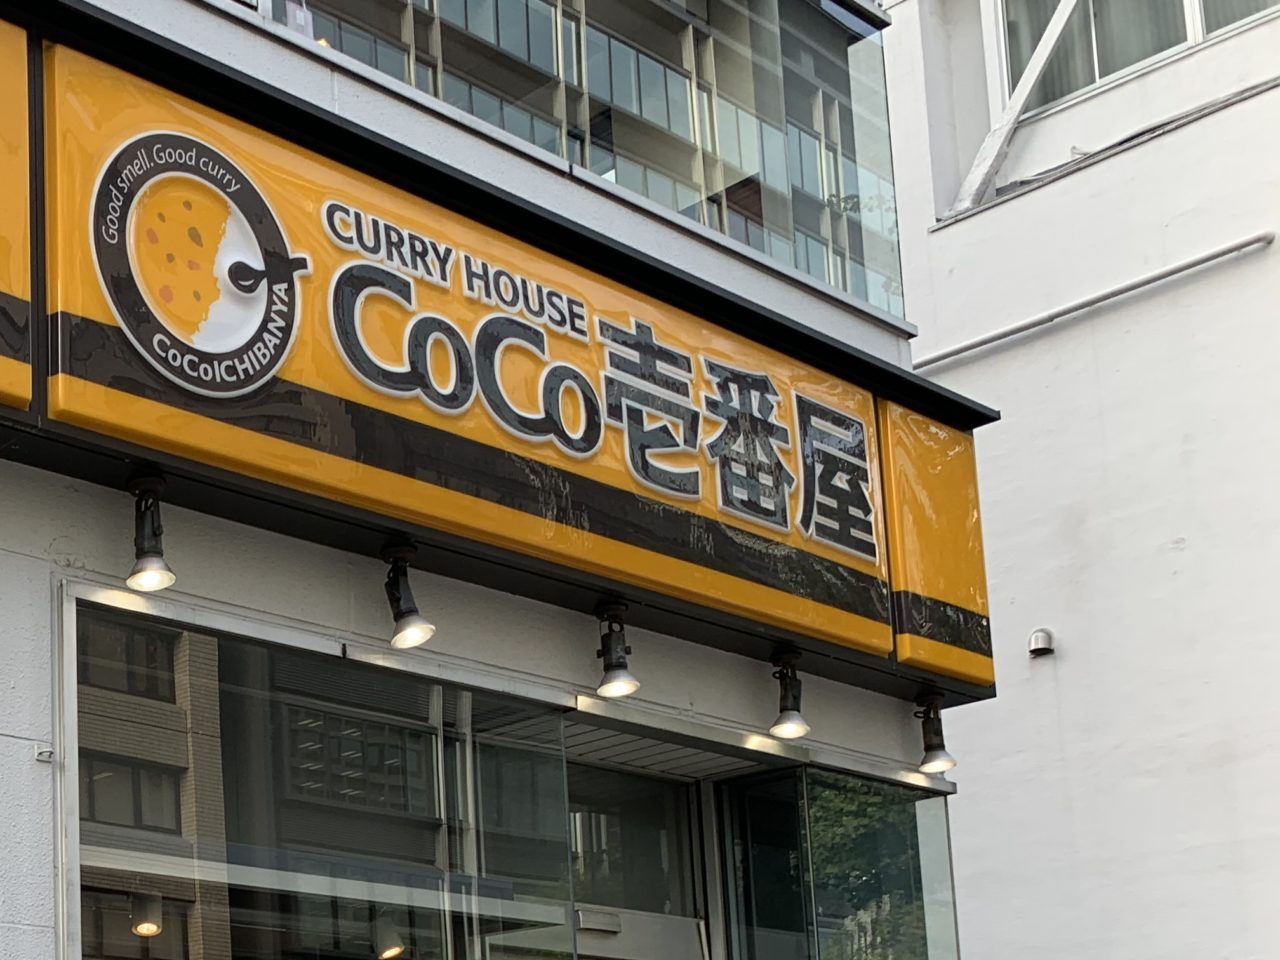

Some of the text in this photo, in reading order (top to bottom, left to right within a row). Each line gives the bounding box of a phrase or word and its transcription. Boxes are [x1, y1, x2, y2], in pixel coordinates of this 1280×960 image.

[102, 143, 242, 245] Good smell. Good curry
[324, 202, 589, 339] CURRY HOUSE
